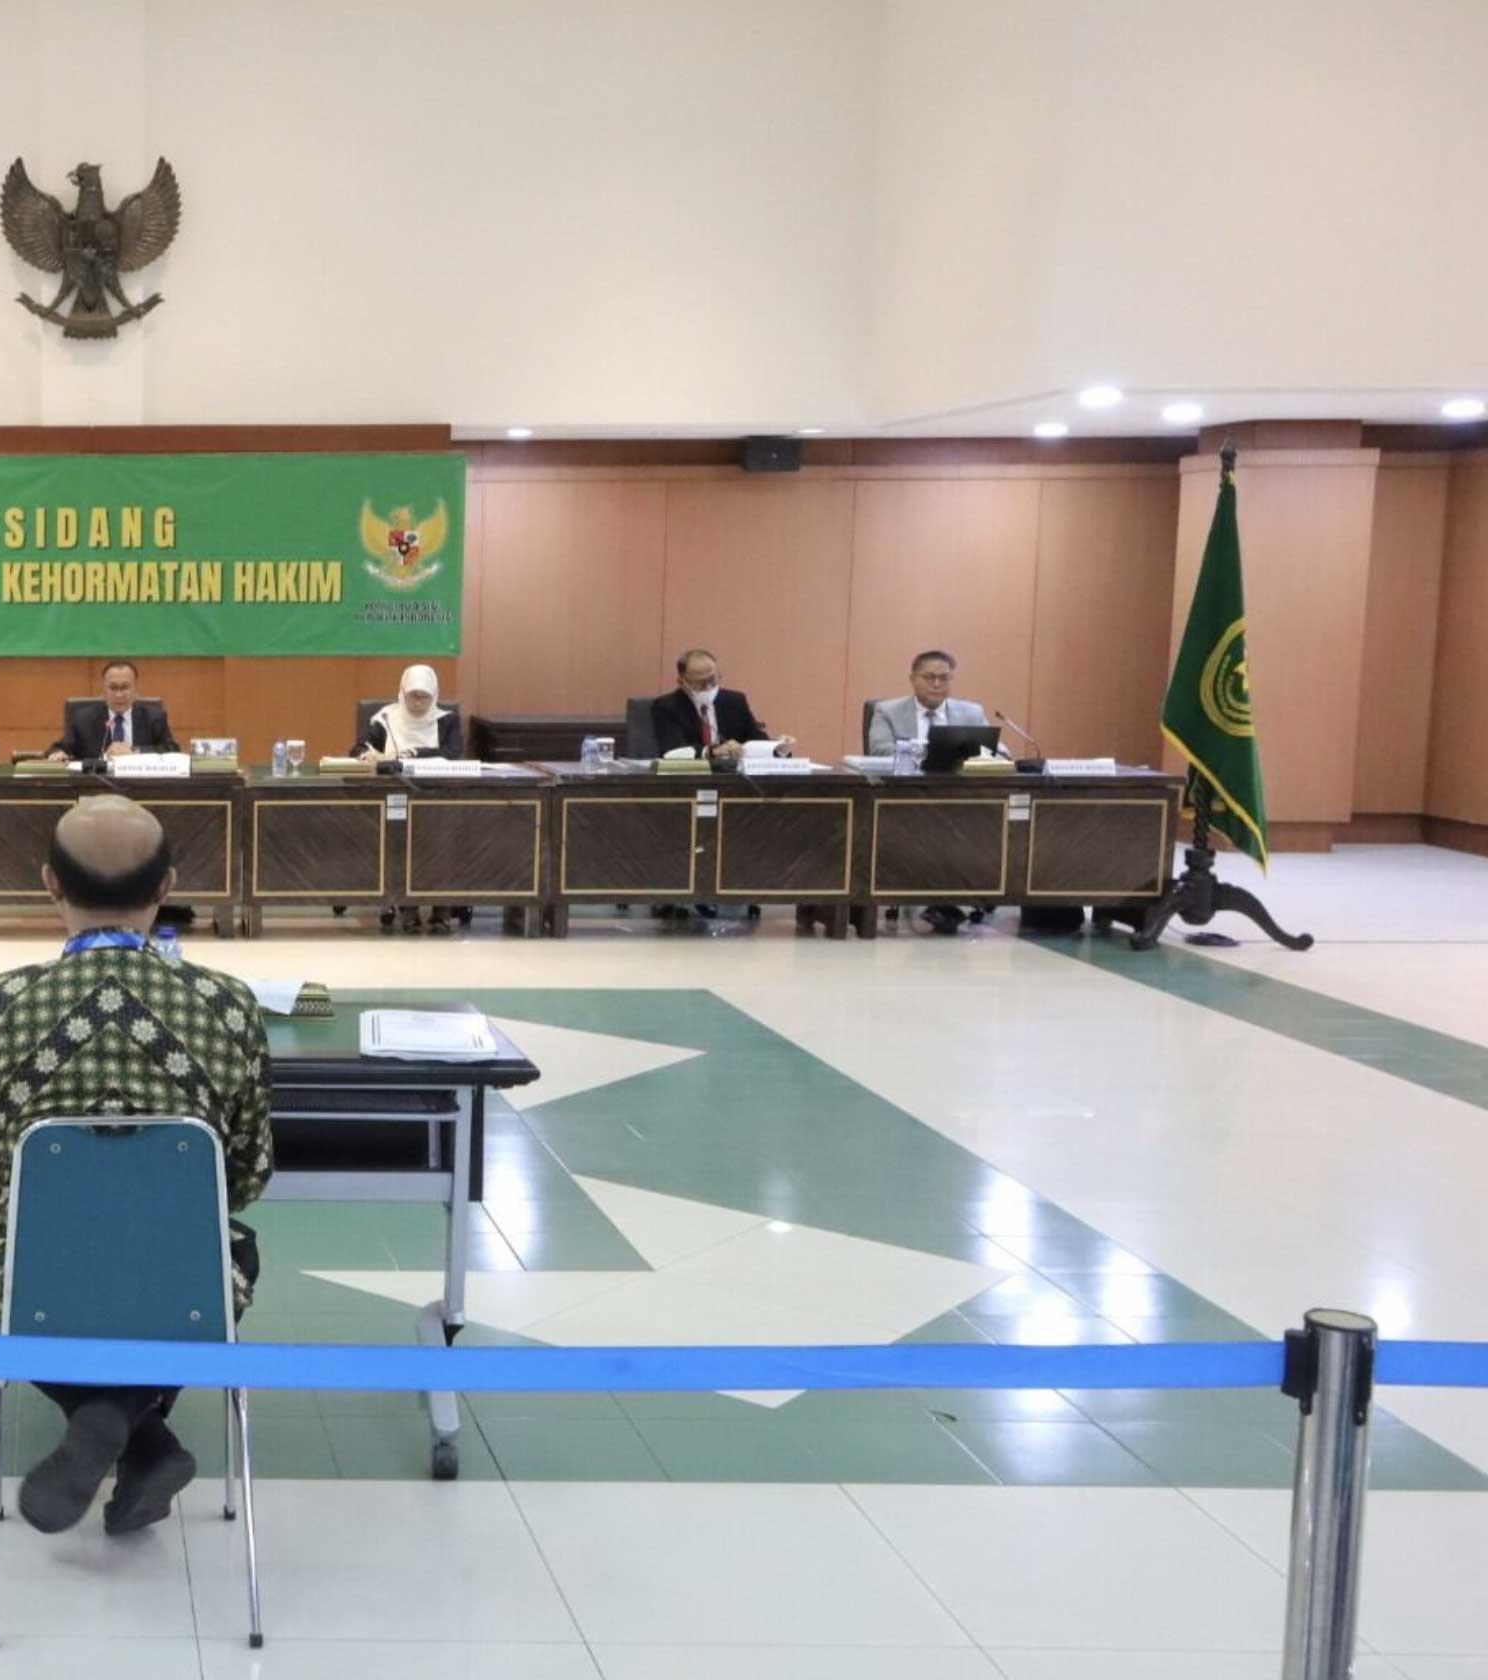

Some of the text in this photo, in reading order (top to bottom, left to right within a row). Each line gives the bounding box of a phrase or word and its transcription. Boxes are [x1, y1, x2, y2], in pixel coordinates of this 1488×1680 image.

[4, 506, 176, 549] SIDANG
[2, 561, 222, 604] KEHORMATAN
[234, 561, 342, 604] HAKIM
